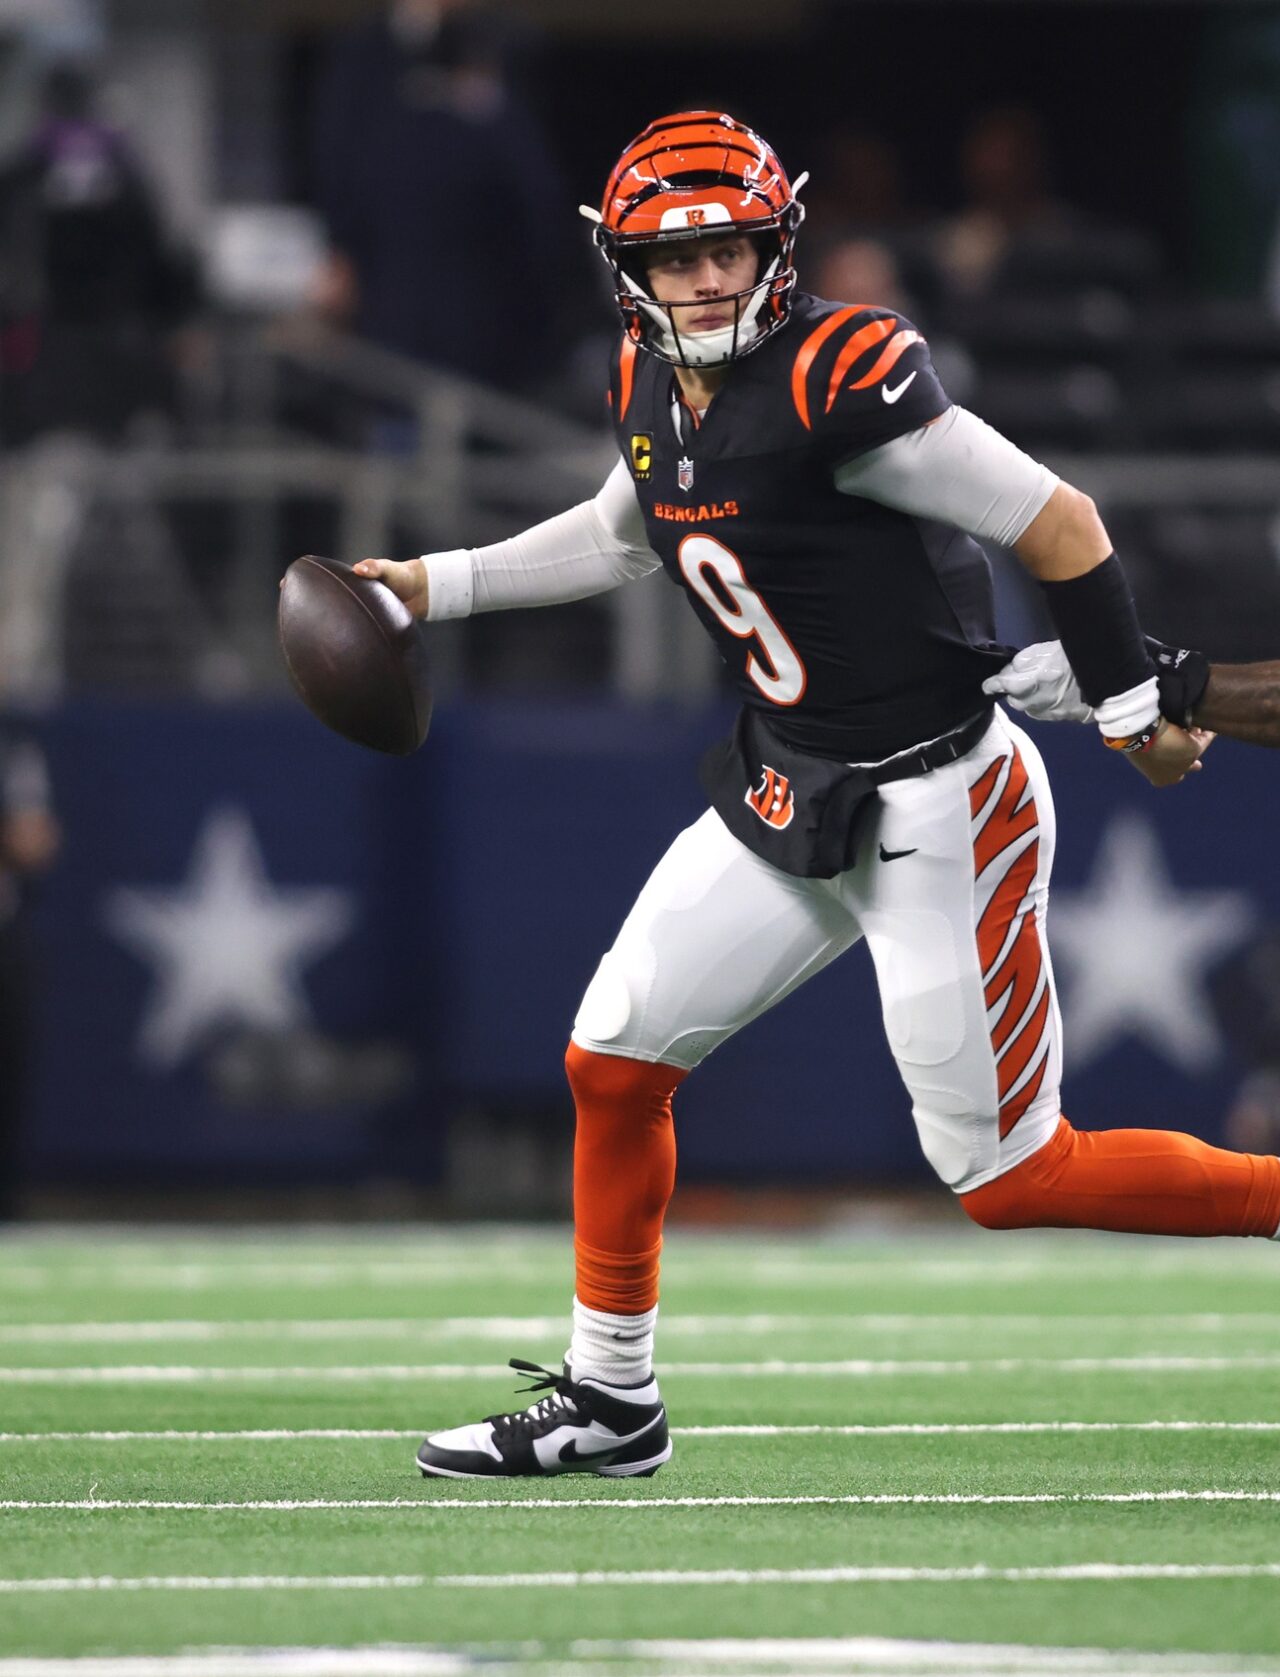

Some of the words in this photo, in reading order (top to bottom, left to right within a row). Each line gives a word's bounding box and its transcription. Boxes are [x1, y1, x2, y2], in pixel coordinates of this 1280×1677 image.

[631, 435, 651, 471] C
[654, 500, 739, 522] BENGALS
[677, 532, 807, 706] 9
